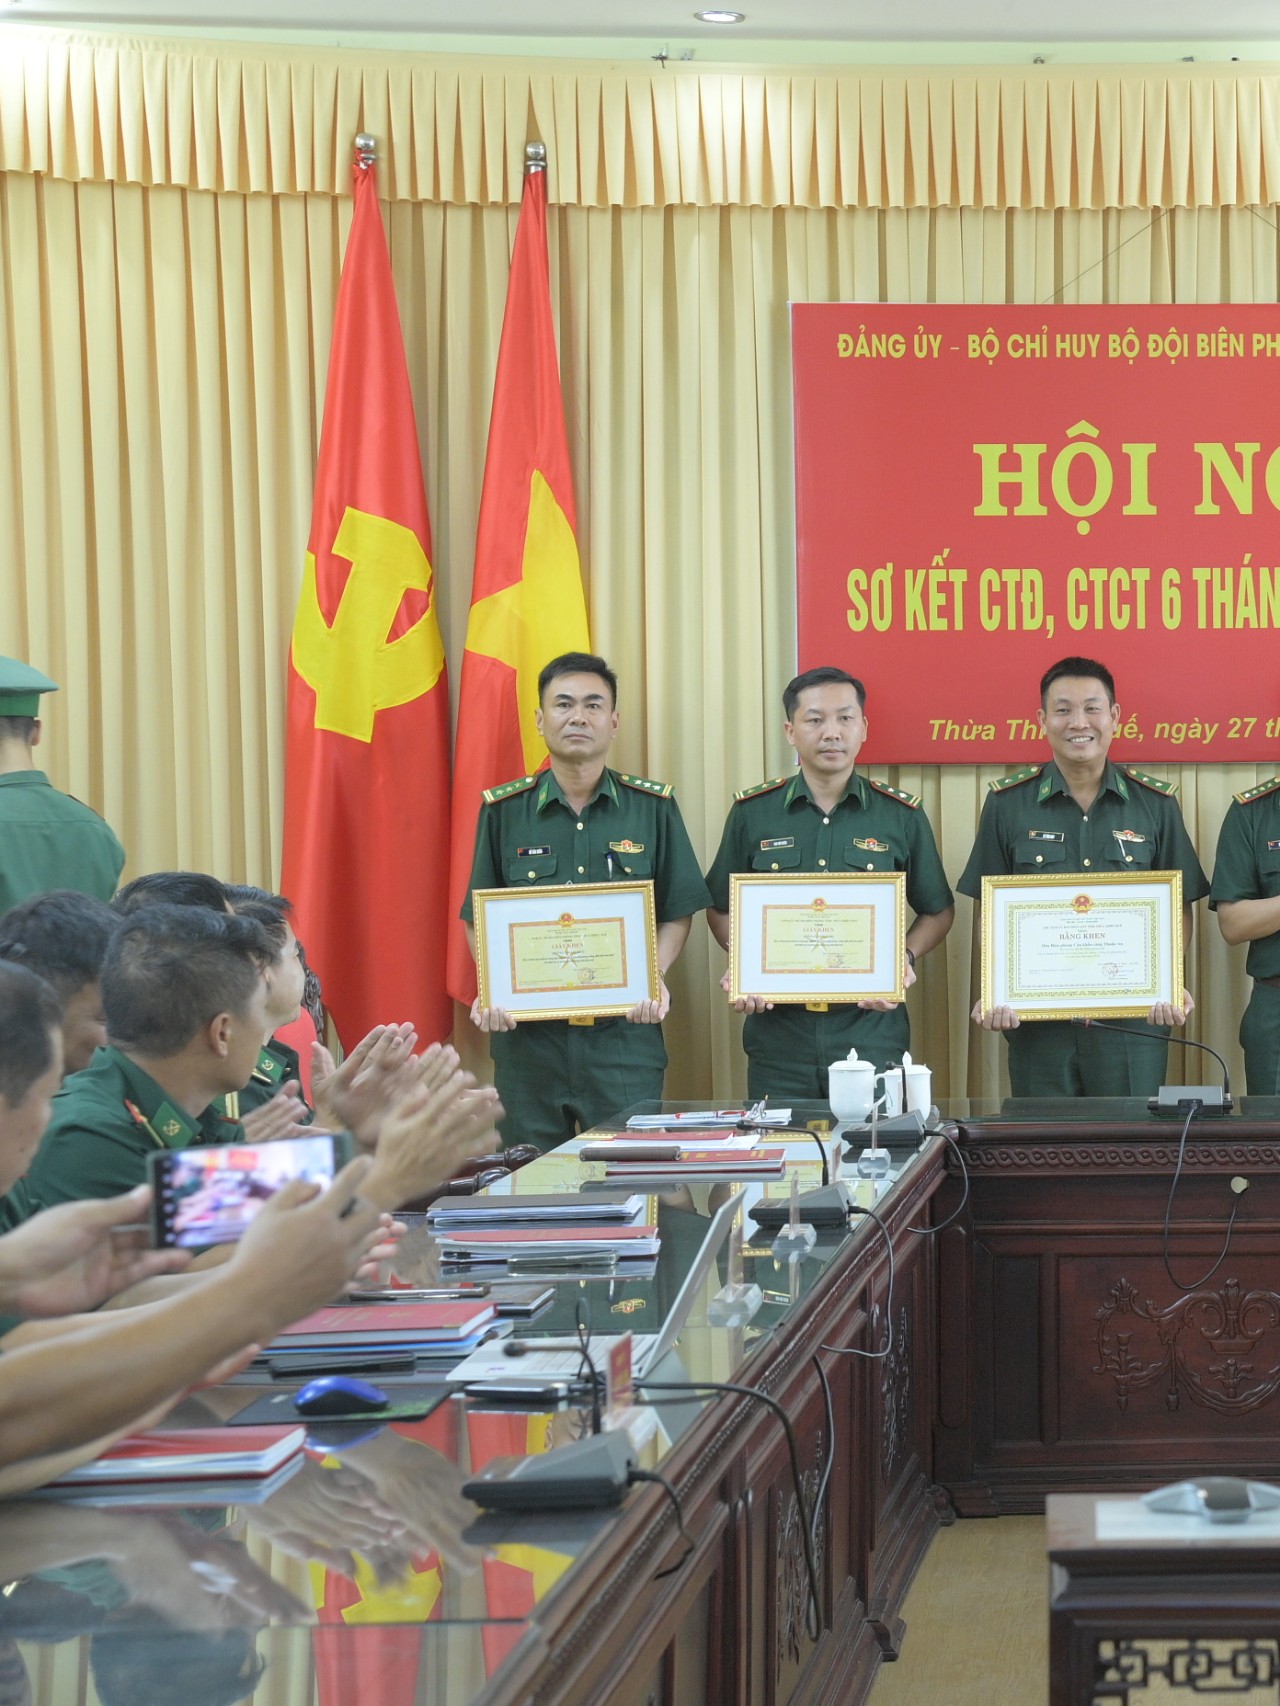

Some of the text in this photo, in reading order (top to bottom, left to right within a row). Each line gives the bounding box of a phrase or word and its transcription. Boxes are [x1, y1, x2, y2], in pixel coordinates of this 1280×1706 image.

[836, 324, 907, 358] ĐẢNG
[912, 325, 943, 358] ỦY
[967, 327, 1000, 365] BỘ
[1007, 325, 1049, 358] CHỈ
[1055, 333, 1101, 358] HUY
[1108, 327, 1141, 365] BỘ
[1147, 327, 1189, 365] ĐỘI
[1196, 326, 1245, 357] BIÊN
[972, 419, 1158, 536] HỘI
[847, 562, 894, 632] SƠ
[904, 548, 969, 632] KẾT
[979, 567, 1055, 639] CTĐ,
[1066, 566, 1151, 631] CTCT
[1161, 567, 1182, 630] 6
[929, 718, 996, 741] Thừa
[1154, 717, 1219, 745] ngày
[1227, 717, 1258, 738] 27
